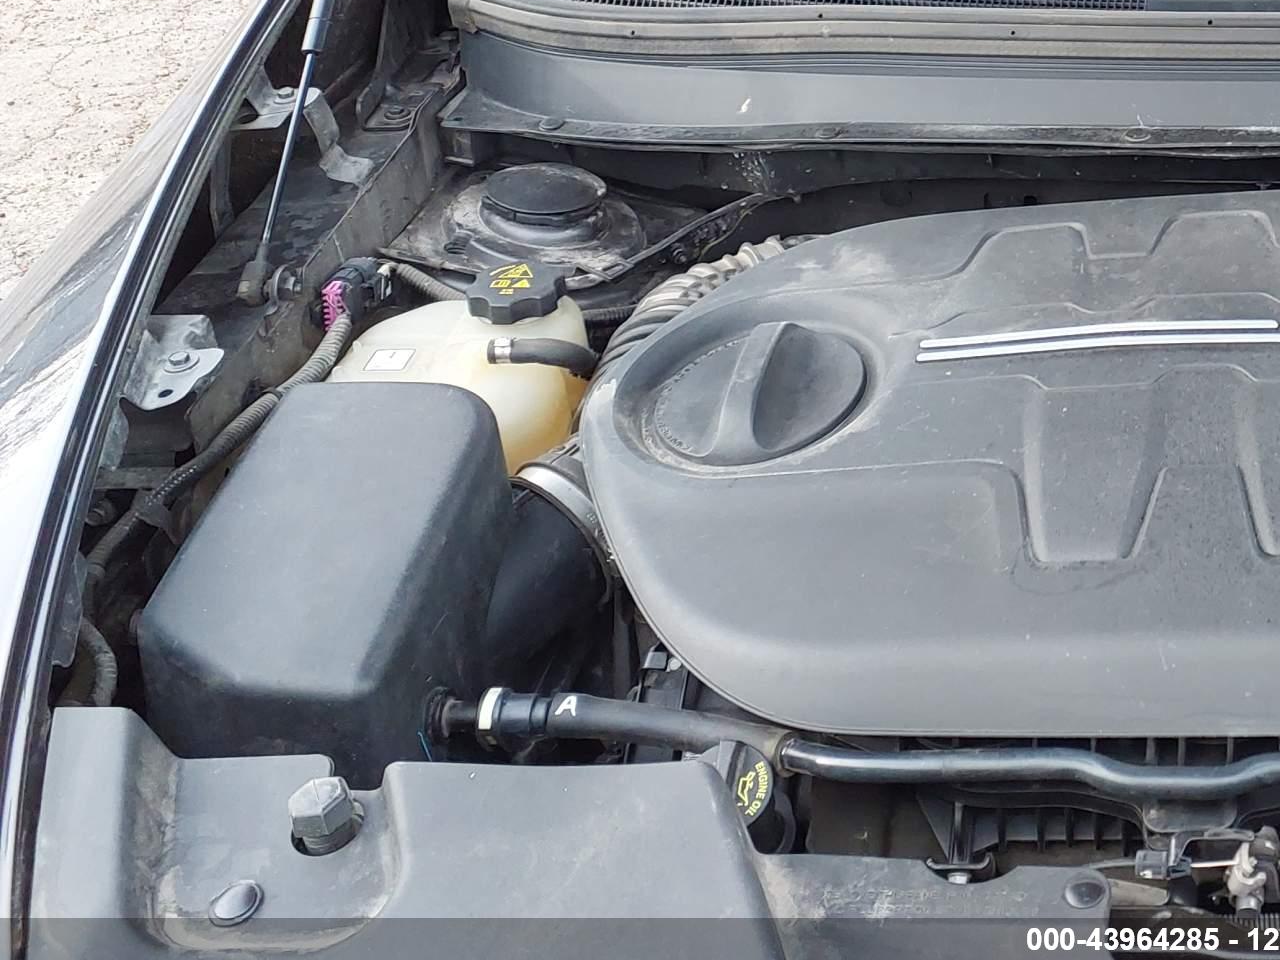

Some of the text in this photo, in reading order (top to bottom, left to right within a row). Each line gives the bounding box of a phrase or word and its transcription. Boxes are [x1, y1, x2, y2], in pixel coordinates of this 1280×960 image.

[555, 695, 577, 717] A
[744, 761, 768, 816] ENGINE OIL
